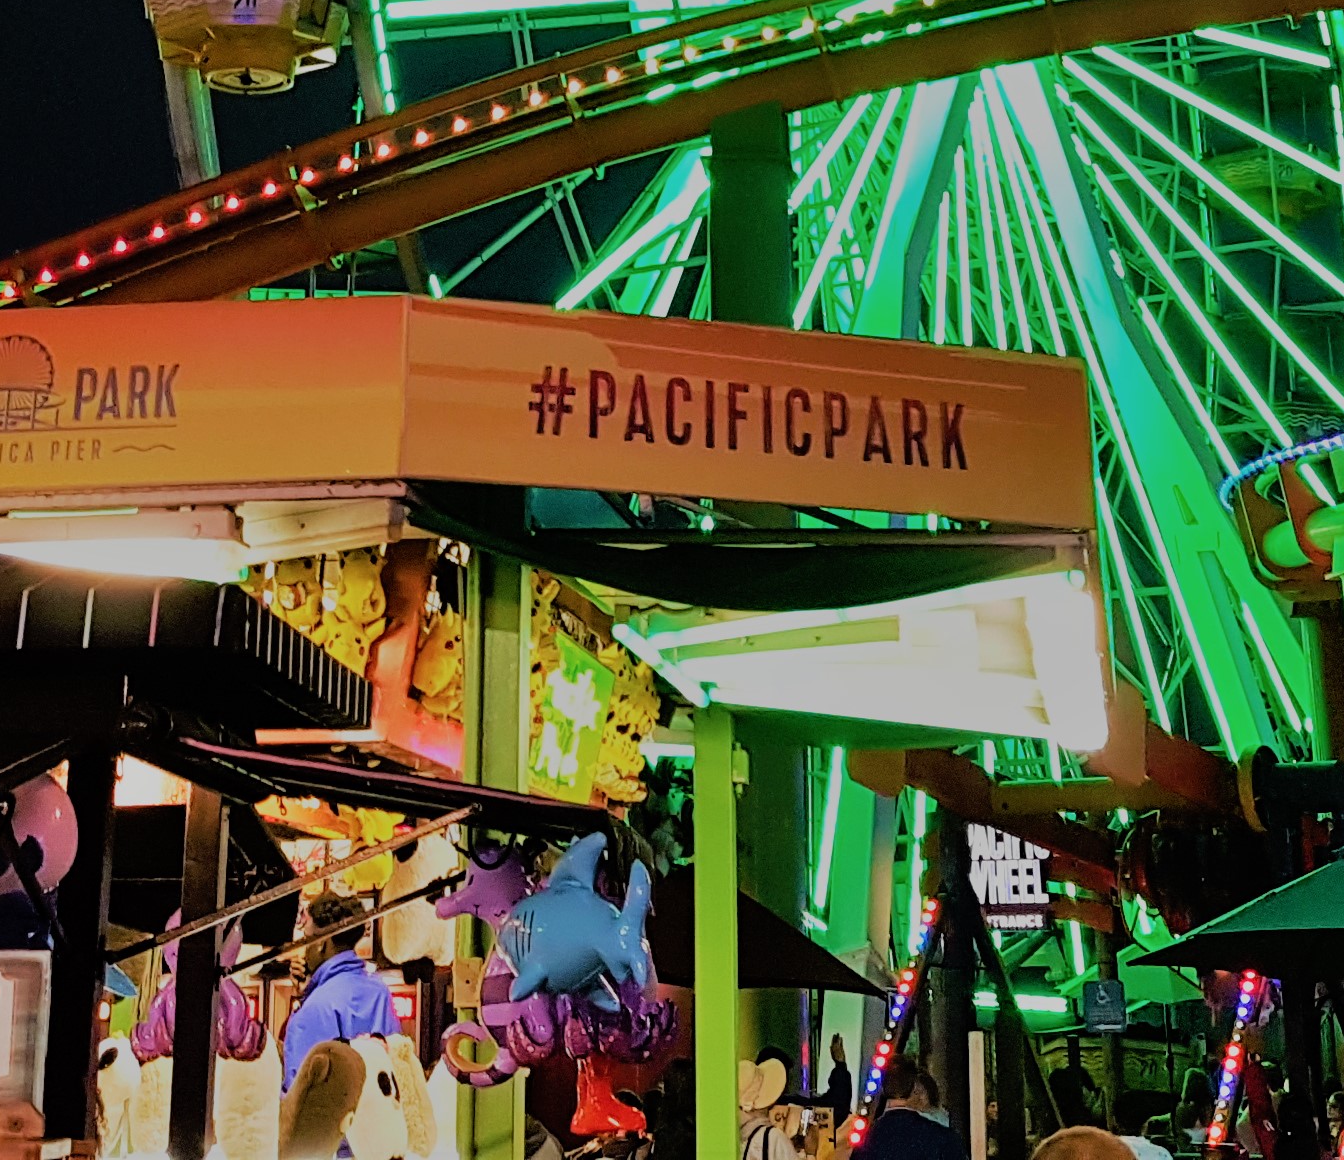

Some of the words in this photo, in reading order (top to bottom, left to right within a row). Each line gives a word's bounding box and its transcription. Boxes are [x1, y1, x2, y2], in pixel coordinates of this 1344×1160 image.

[72, 364, 180, 422] PARK
[528, 365, 969, 471] #PACIFICPARK
[49, 438, 103, 462] PIER
[968, 859, 1050, 905] WHEEL
[986, 914, 1044, 930] TRANCE
